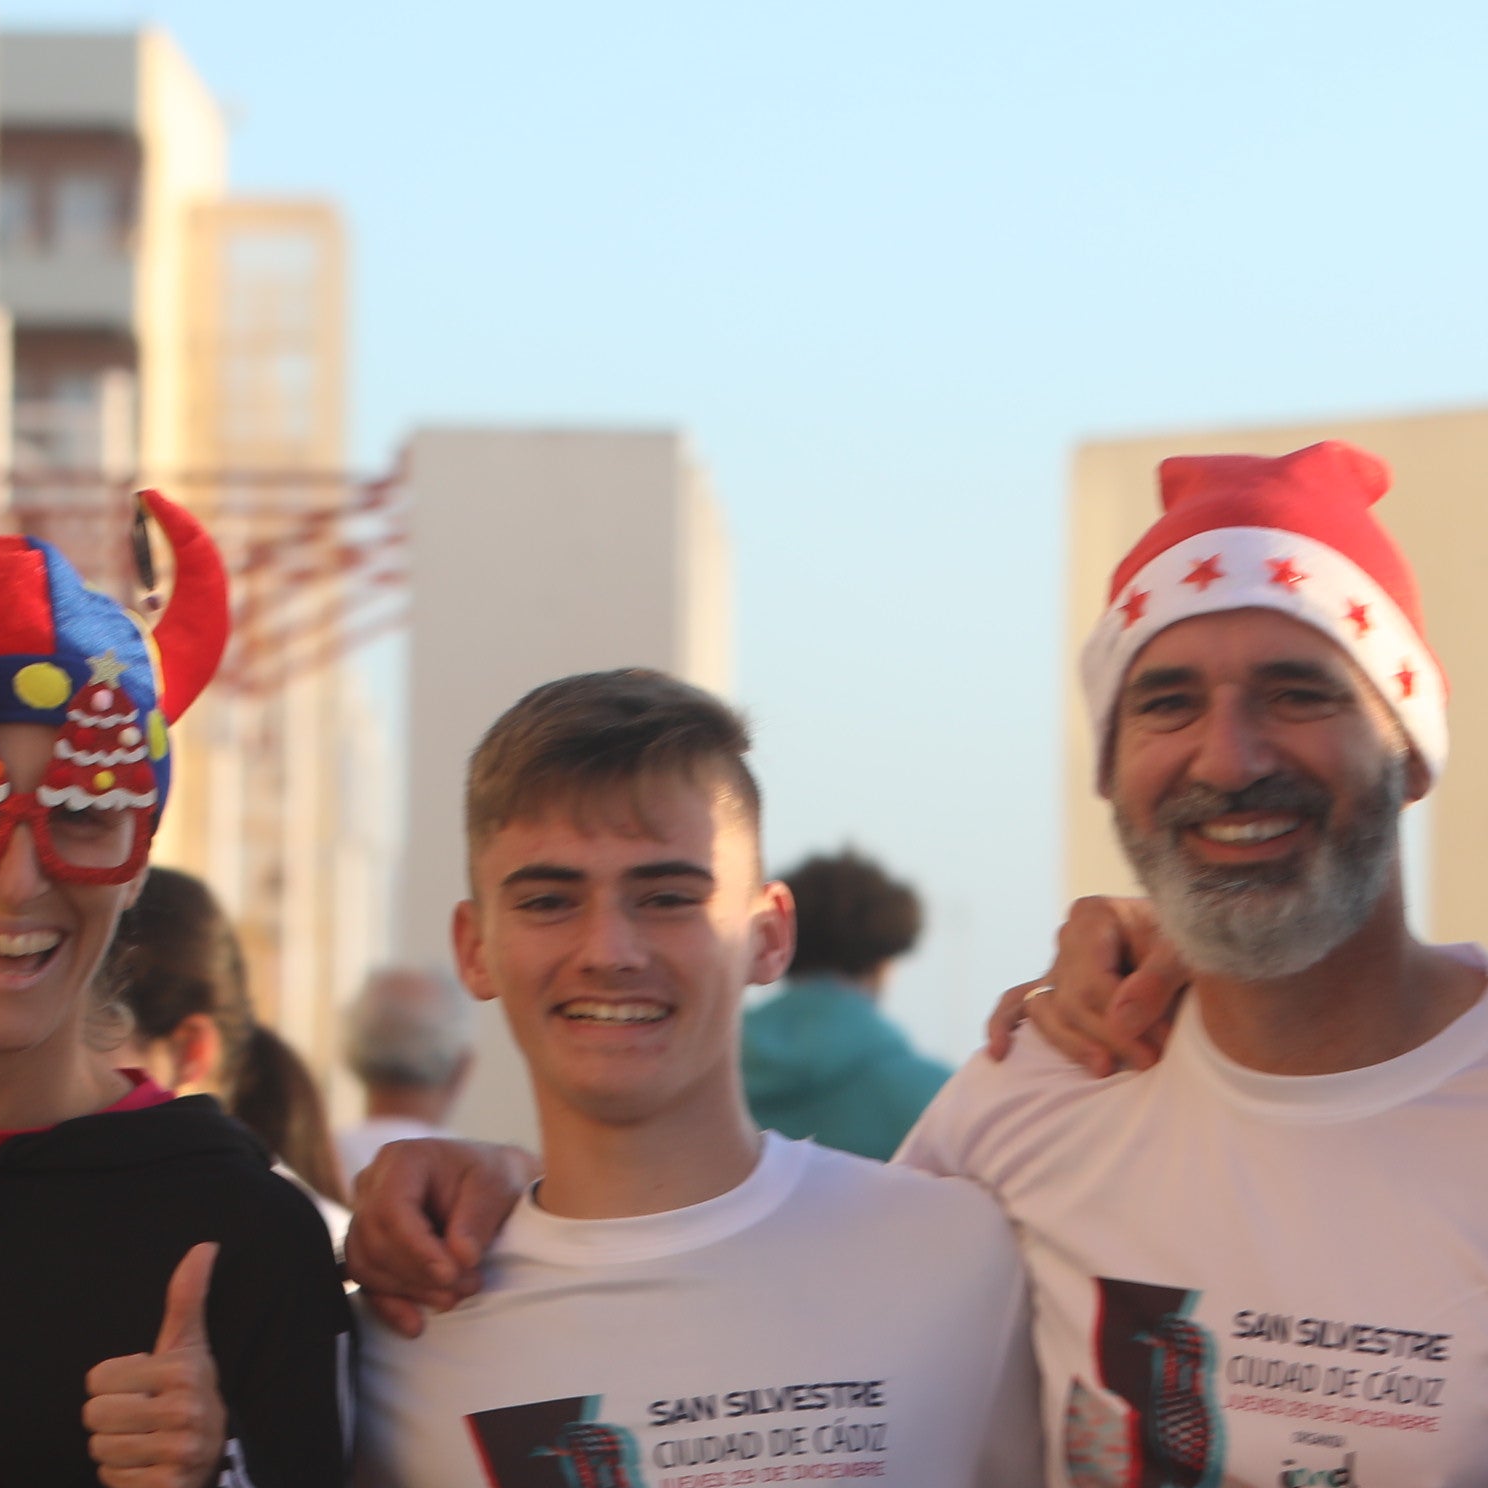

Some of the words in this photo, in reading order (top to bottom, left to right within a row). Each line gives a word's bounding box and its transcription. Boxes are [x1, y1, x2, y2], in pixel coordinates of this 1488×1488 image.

[1232, 1310, 1293, 1343] SAN
[1296, 1318, 1453, 1361] SILVESTRE
[648, 1394, 717, 1427] SAN
[722, 1380, 886, 1417] SILVESTRE
[1226, 1354, 1321, 1393] CIUDAD
[1322, 1367, 1361, 1398] DE
[1364, 1365, 1446, 1407] CÁDIZ
[652, 1431, 763, 1468] CIUDAD
[768, 1426, 808, 1457] DE
[813, 1416, 888, 1454] CÁDIZ
[761, 1466, 788, 1483] DE
[793, 1460, 886, 1481] DICIEMBRE
